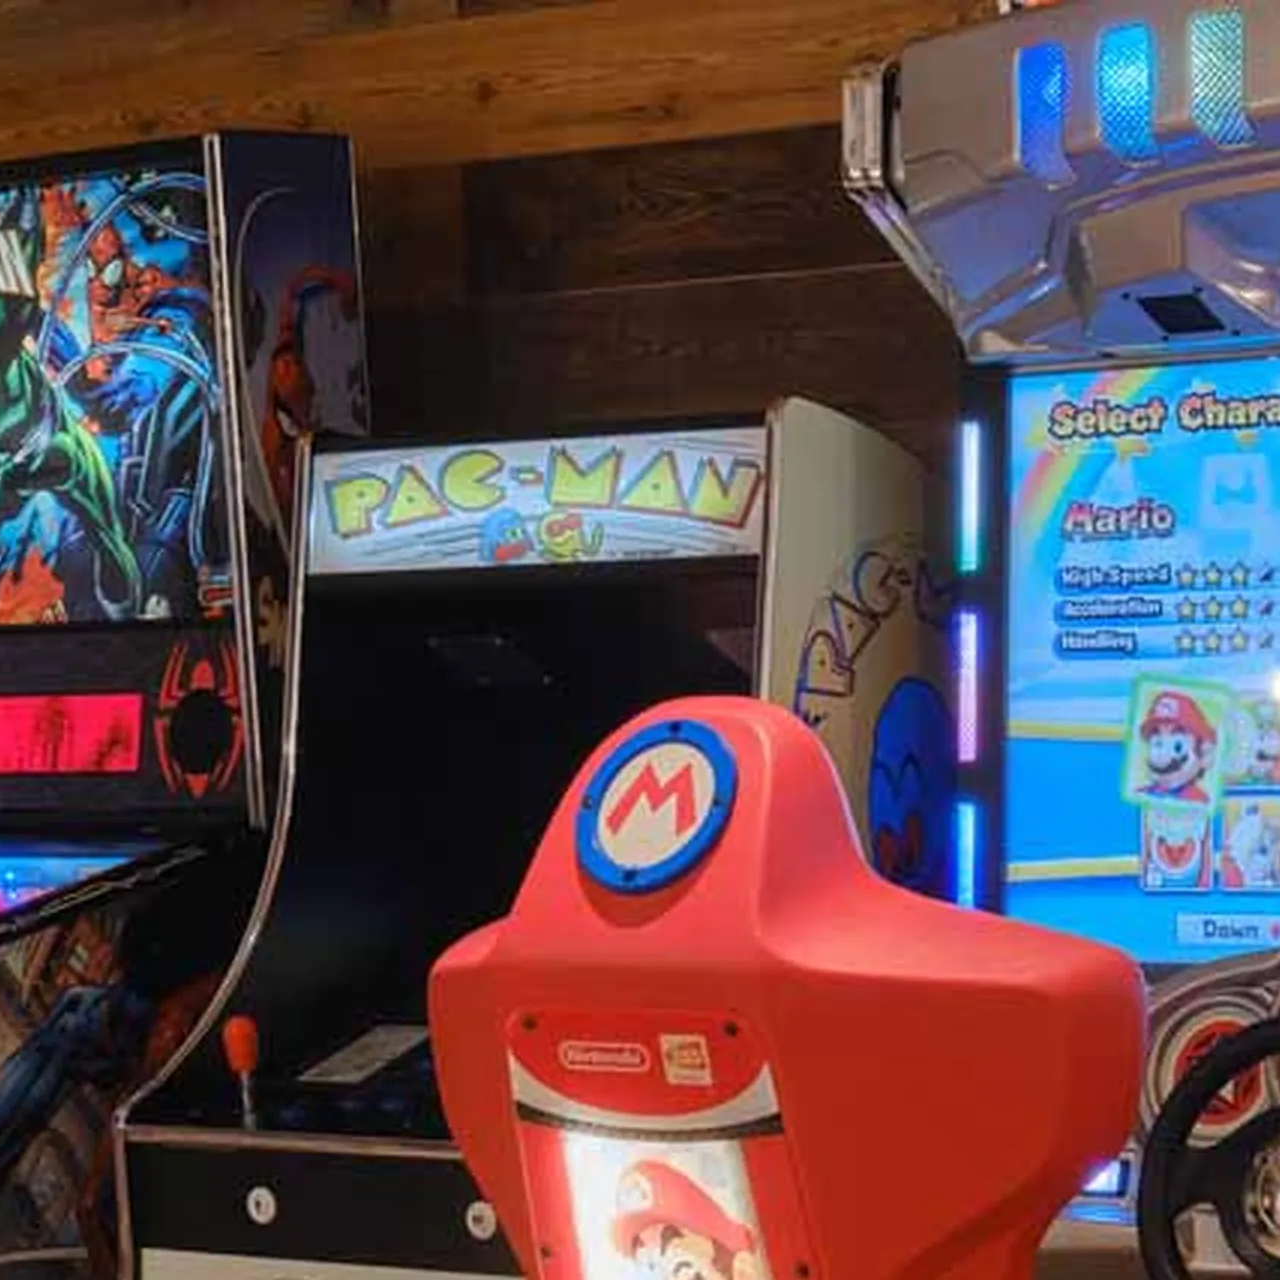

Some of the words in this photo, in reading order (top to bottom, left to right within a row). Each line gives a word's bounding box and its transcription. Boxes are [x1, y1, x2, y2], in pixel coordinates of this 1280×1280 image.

[1049, 400, 1167, 439] Select
[324, 444, 766, 540] PAC-MAN
[1063, 498, 1175, 540] Mario
[606, 760, 697, 837] M
[1202, 917, 1260, 940] Down
